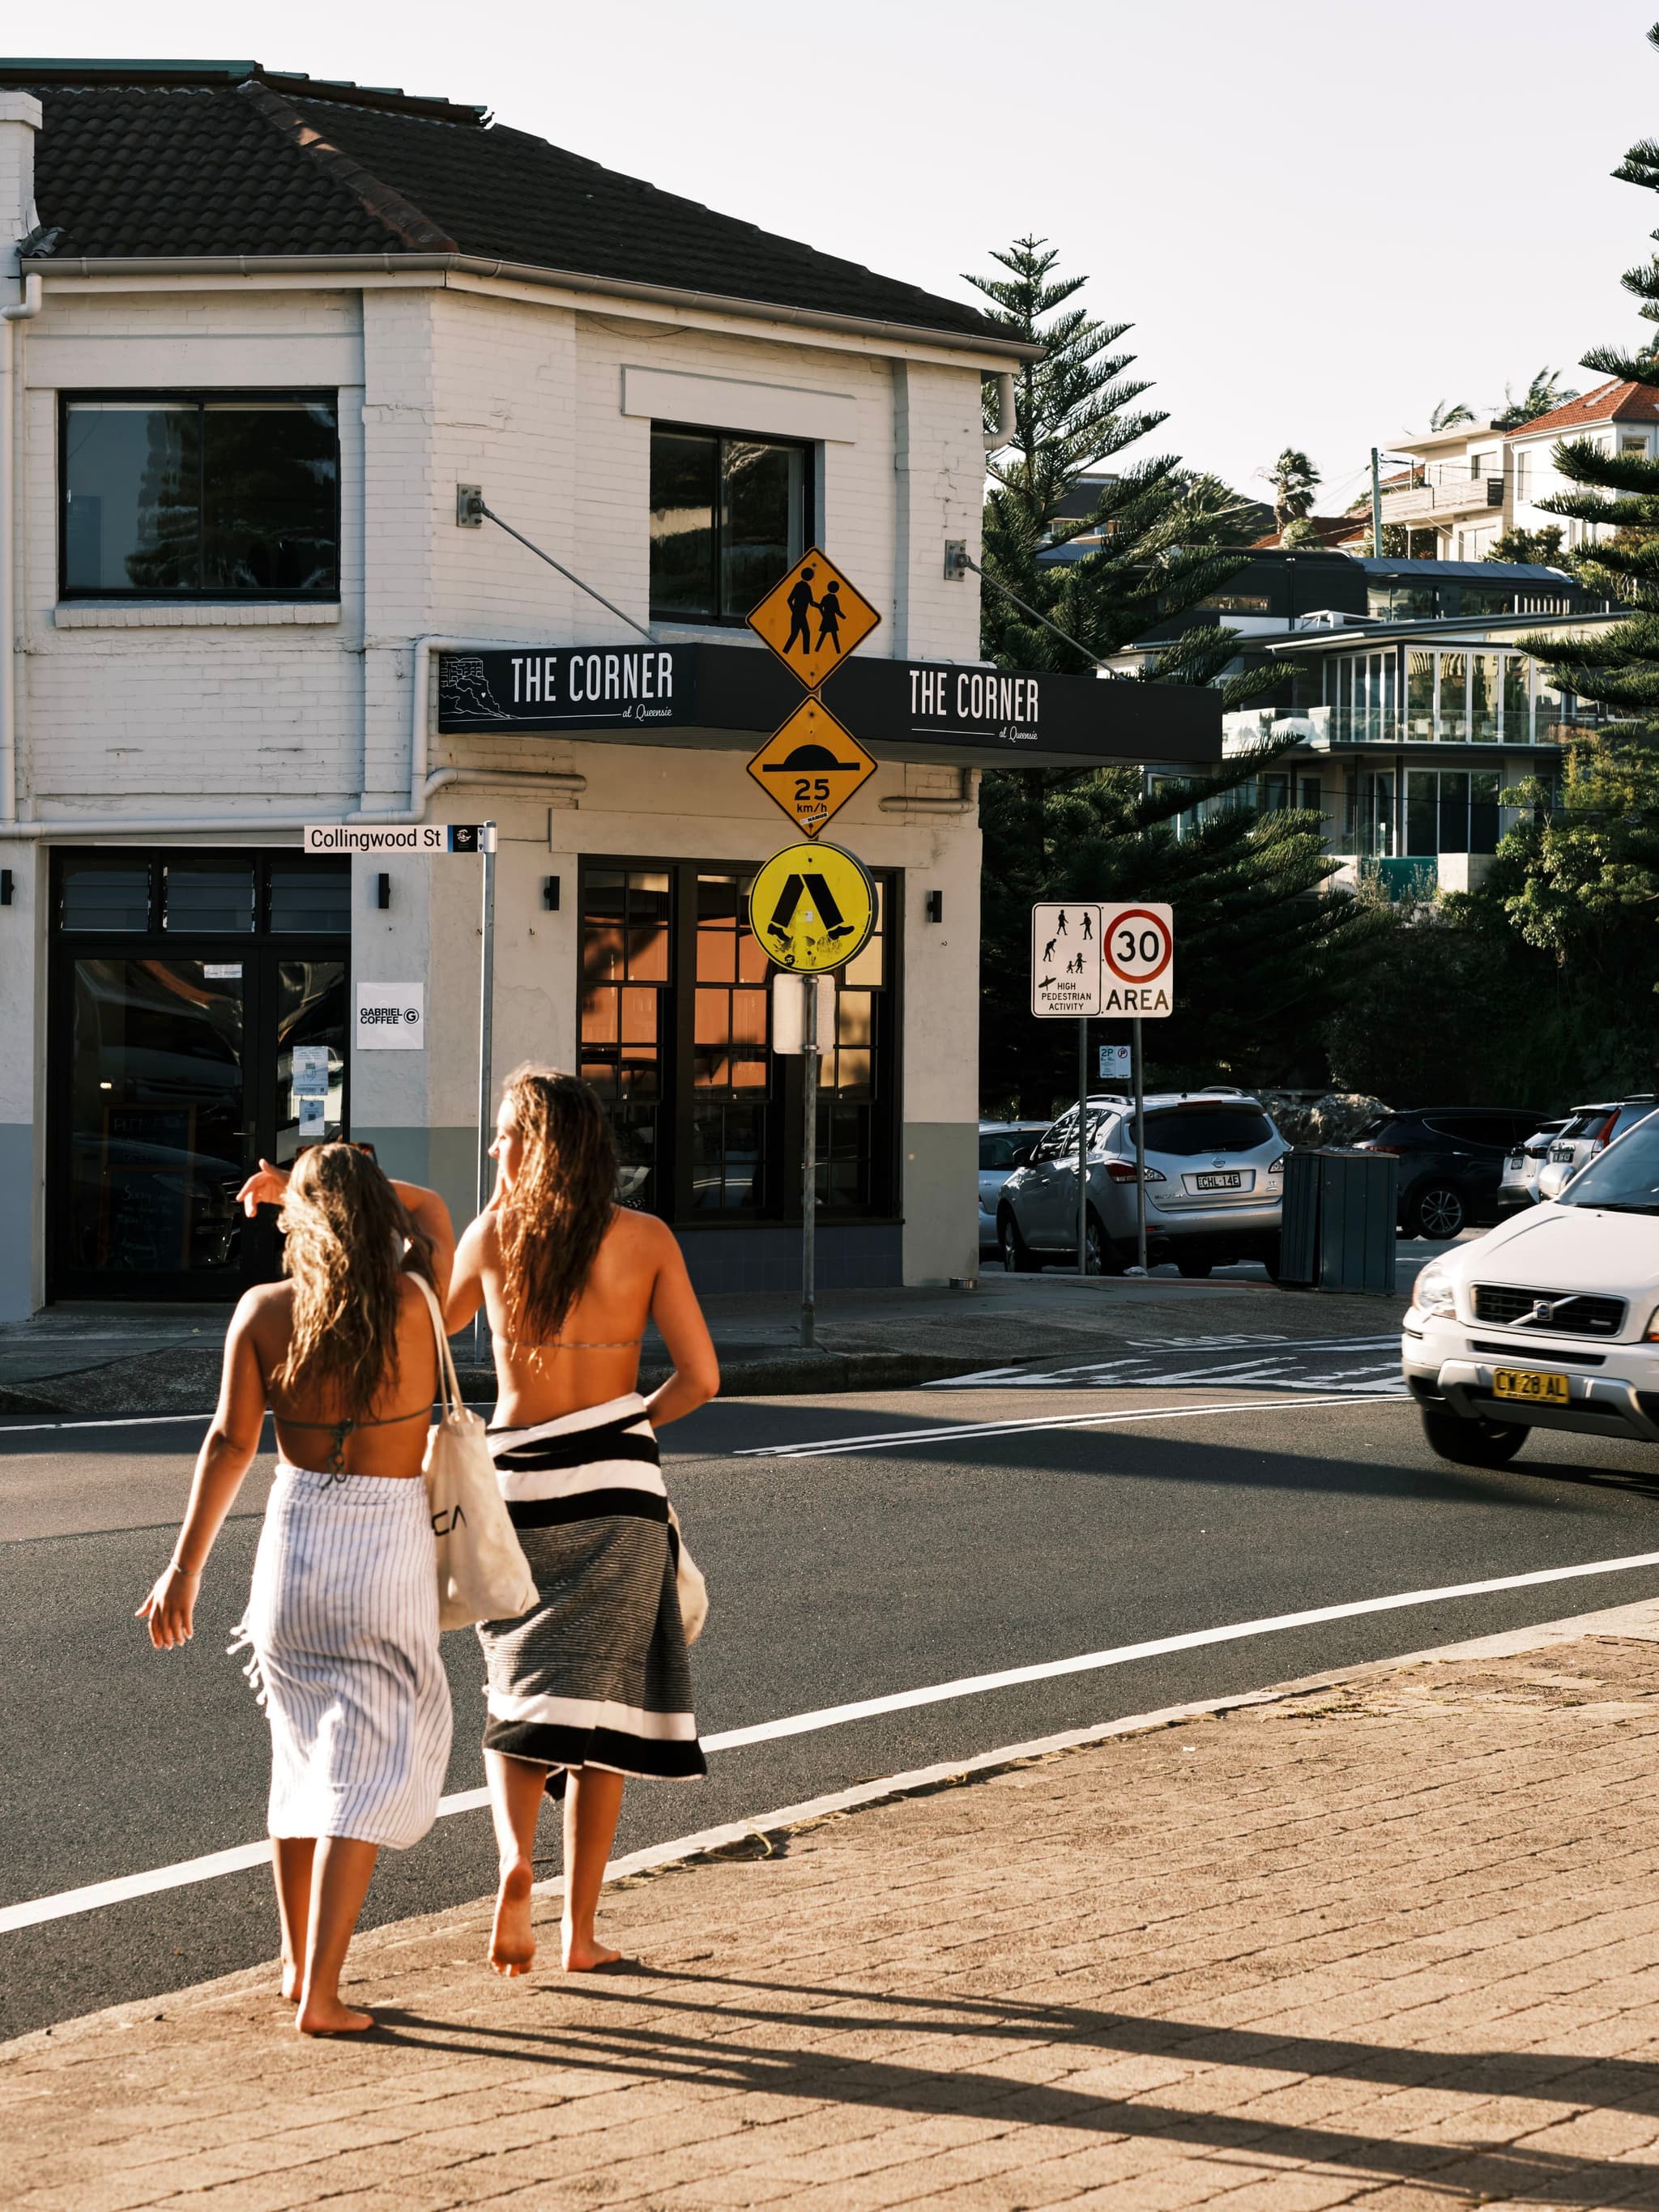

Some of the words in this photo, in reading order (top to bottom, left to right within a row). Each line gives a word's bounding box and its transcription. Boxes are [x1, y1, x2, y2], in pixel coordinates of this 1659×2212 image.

[511, 656, 557, 702] THE
[569, 652, 673, 701] CORNER
[909, 670, 948, 715] THE
[957, 673, 1038, 722] CORNER
[622, 705, 632, 718] at
[634, 703, 673, 722] Queensie
[999, 727, 1007, 738] at
[1008, 726, 1038, 743] Queensie
[794, 778, 830, 800] 25
[796, 803, 827, 812] km/h
[311, 828, 417, 851] Collingwood
[423, 829, 441, 846] St
[1116, 931, 1160, 962] 30
[1106, 989, 1169, 1010] AREA
[360, 1008, 403, 1016] GABRIEL
[360, 1016, 399, 1024] COFFEE
